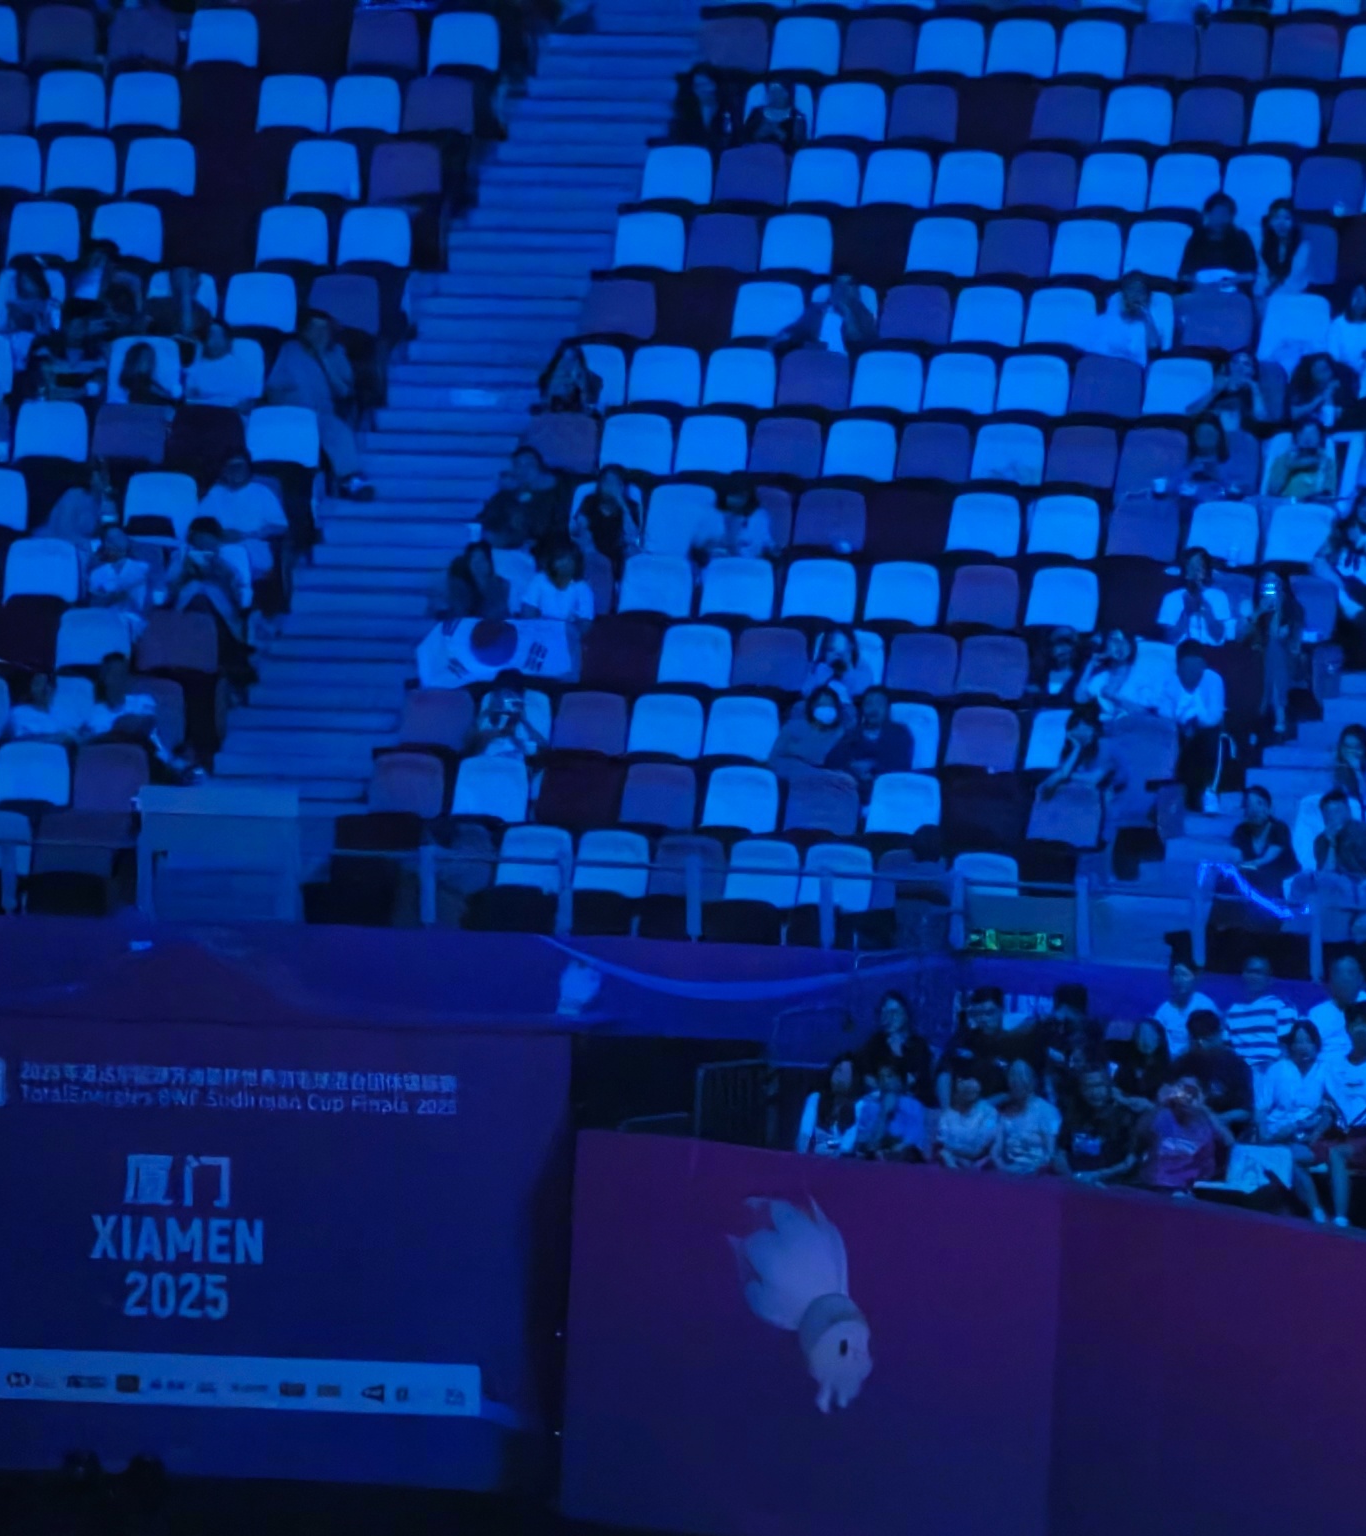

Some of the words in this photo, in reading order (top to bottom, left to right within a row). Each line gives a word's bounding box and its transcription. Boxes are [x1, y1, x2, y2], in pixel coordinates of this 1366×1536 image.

[124, 1153, 231, 1208] 厦门
[90, 1214, 264, 1265] XIAMEN
[123, 1270, 230, 1320] 2025
